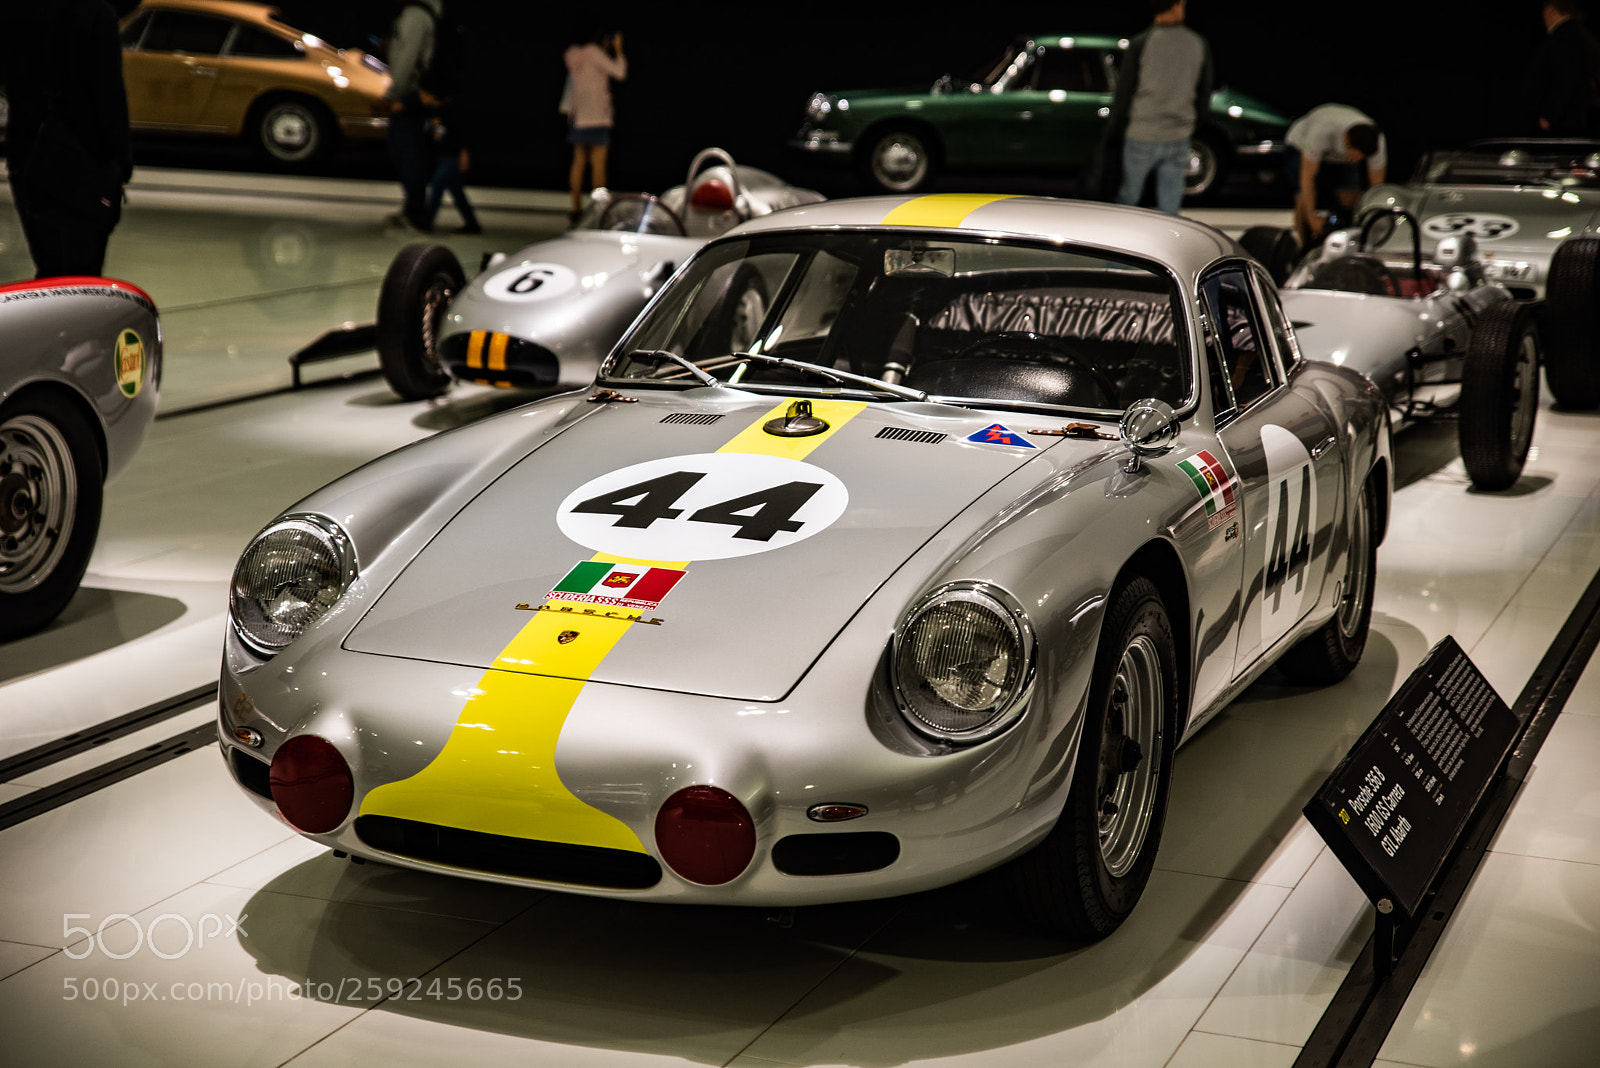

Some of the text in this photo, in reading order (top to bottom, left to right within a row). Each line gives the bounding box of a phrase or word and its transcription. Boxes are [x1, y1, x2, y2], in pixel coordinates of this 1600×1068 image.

[507, 270, 554, 294] 6
[569, 470, 825, 542] 44
[1263, 463, 1311, 616] 44
[546, 591, 619, 606] SCUDERIA SSS
[1347, 765, 1386, 816] Porsche 356 B
[1364, 783, 1406, 837] 1600 GS Carrera
[1380, 814, 1412, 858] GTL Abarth
